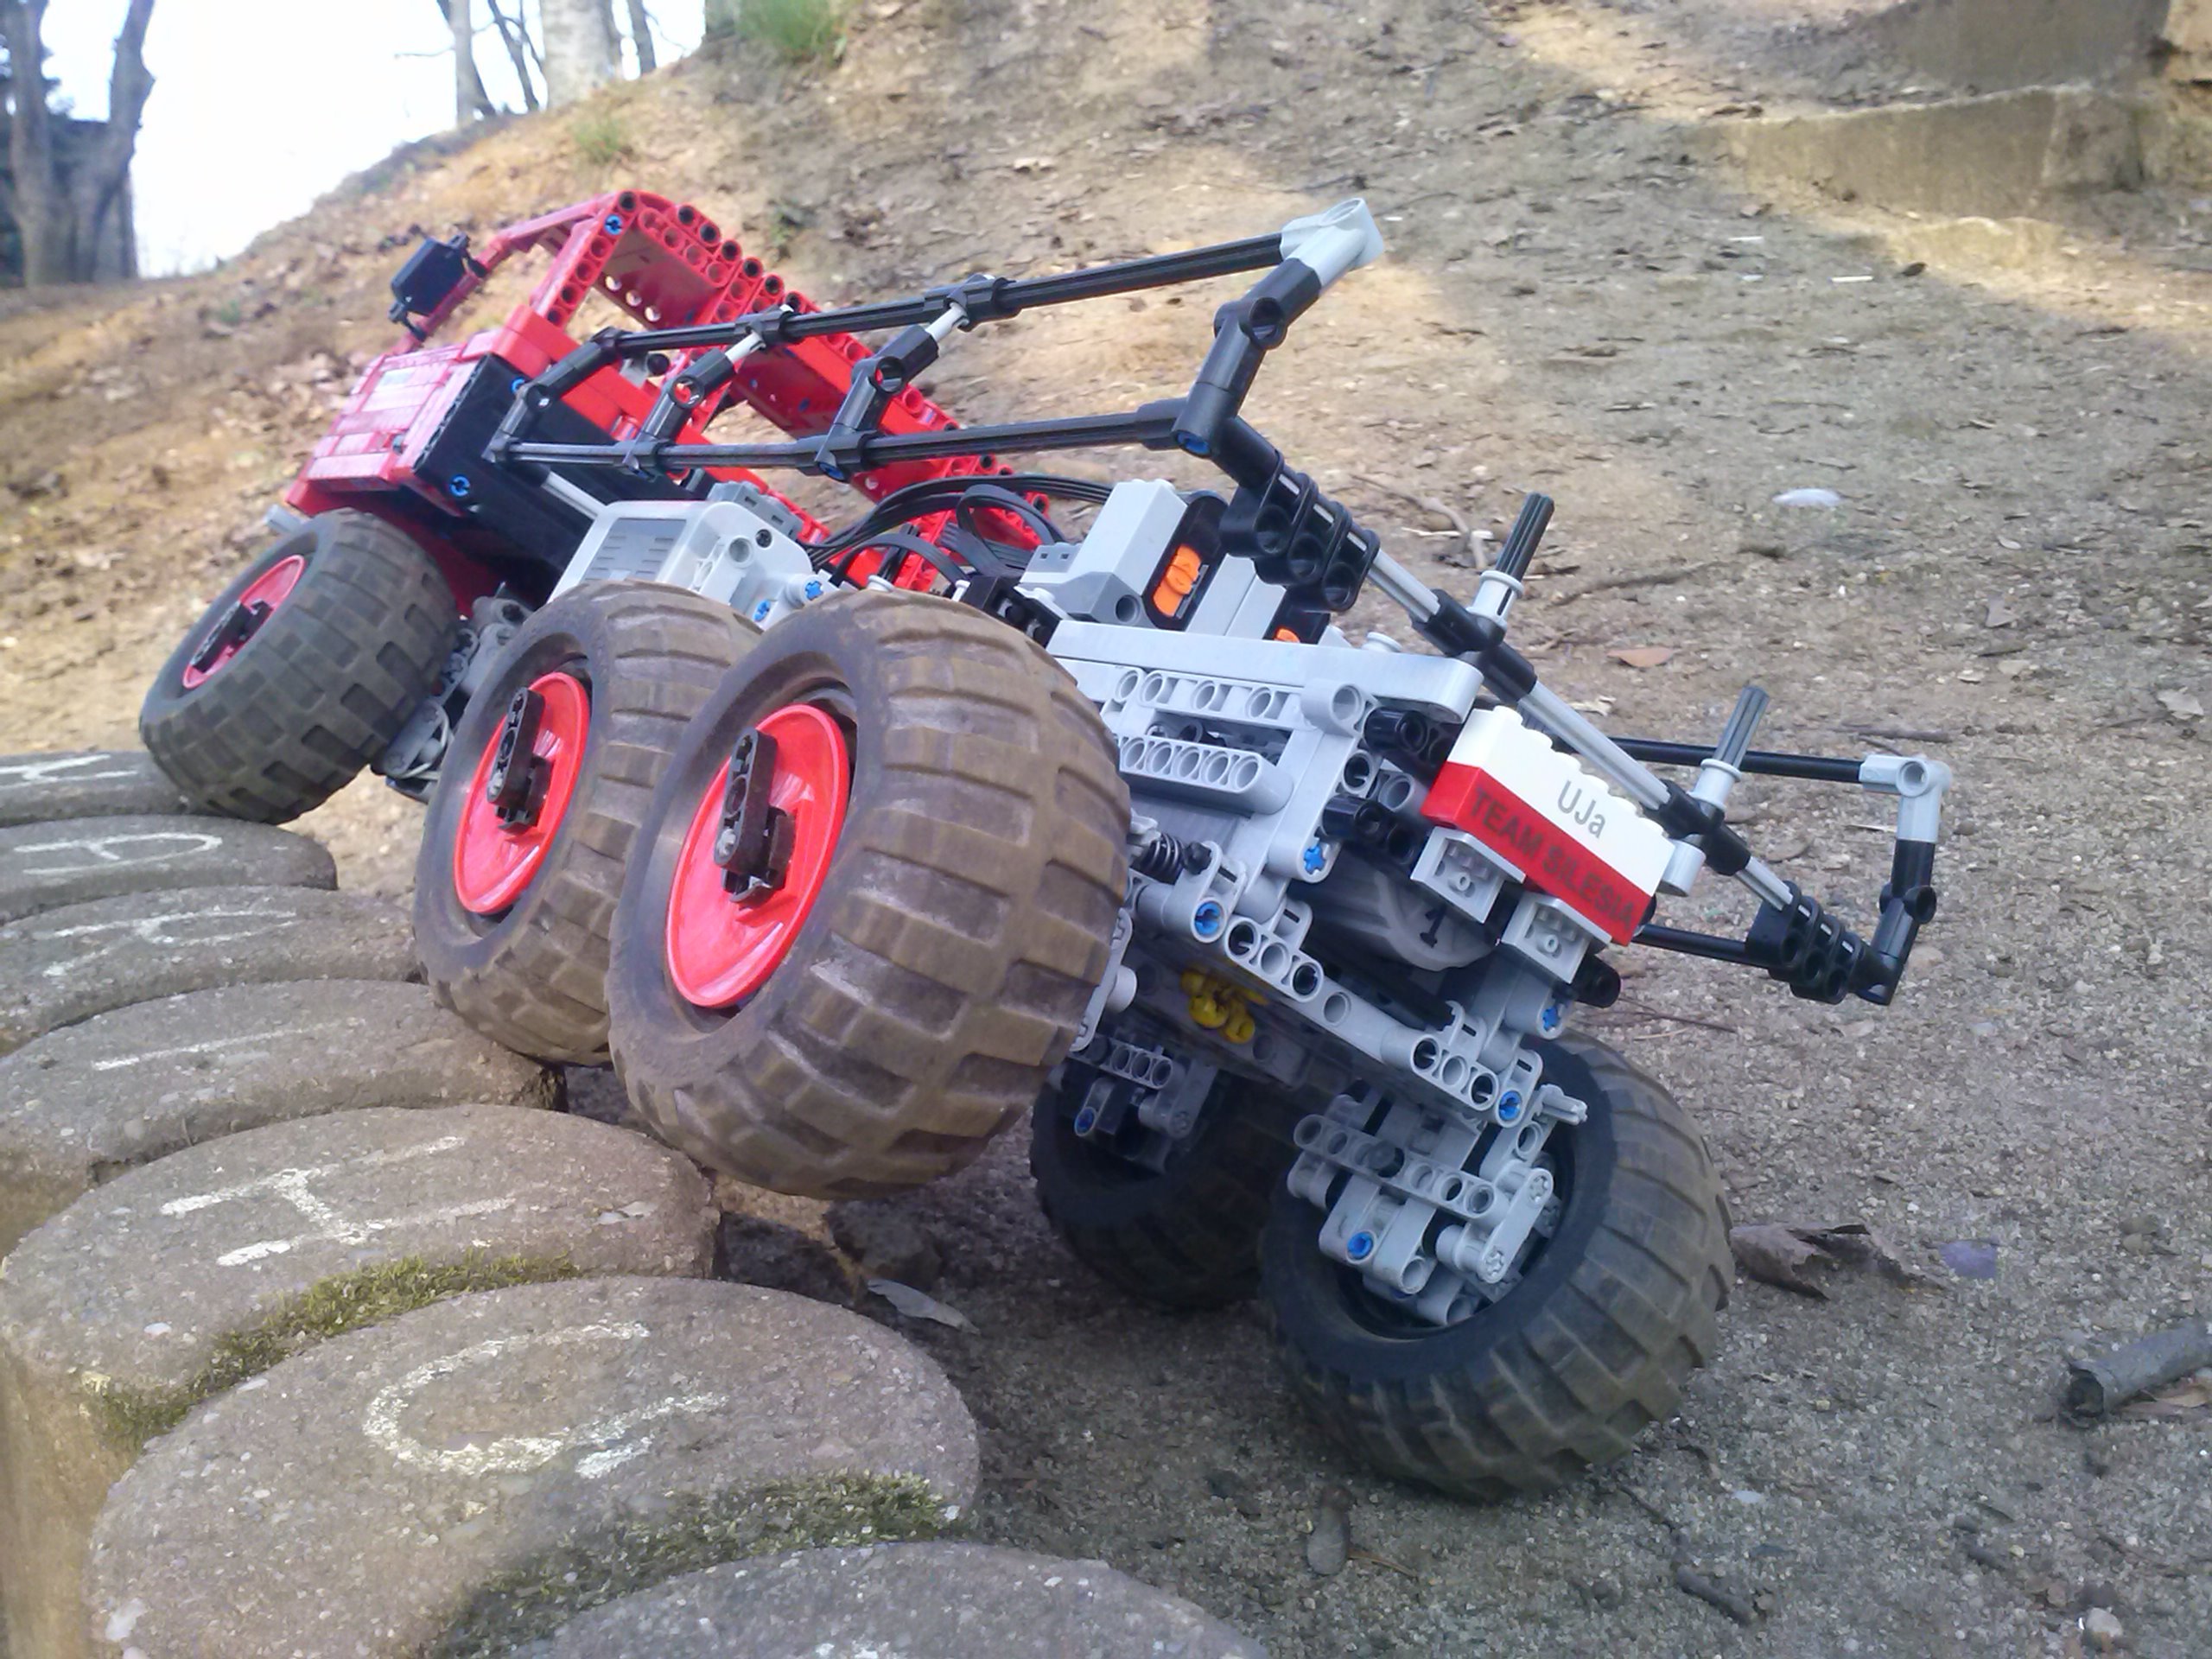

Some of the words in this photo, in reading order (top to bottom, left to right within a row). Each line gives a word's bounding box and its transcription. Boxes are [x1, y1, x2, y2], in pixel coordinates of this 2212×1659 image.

[1467, 787, 1539, 858] TEAM
[1541, 846, 1637, 931] SILESIA
[1557, 780, 1606, 839] UJa
